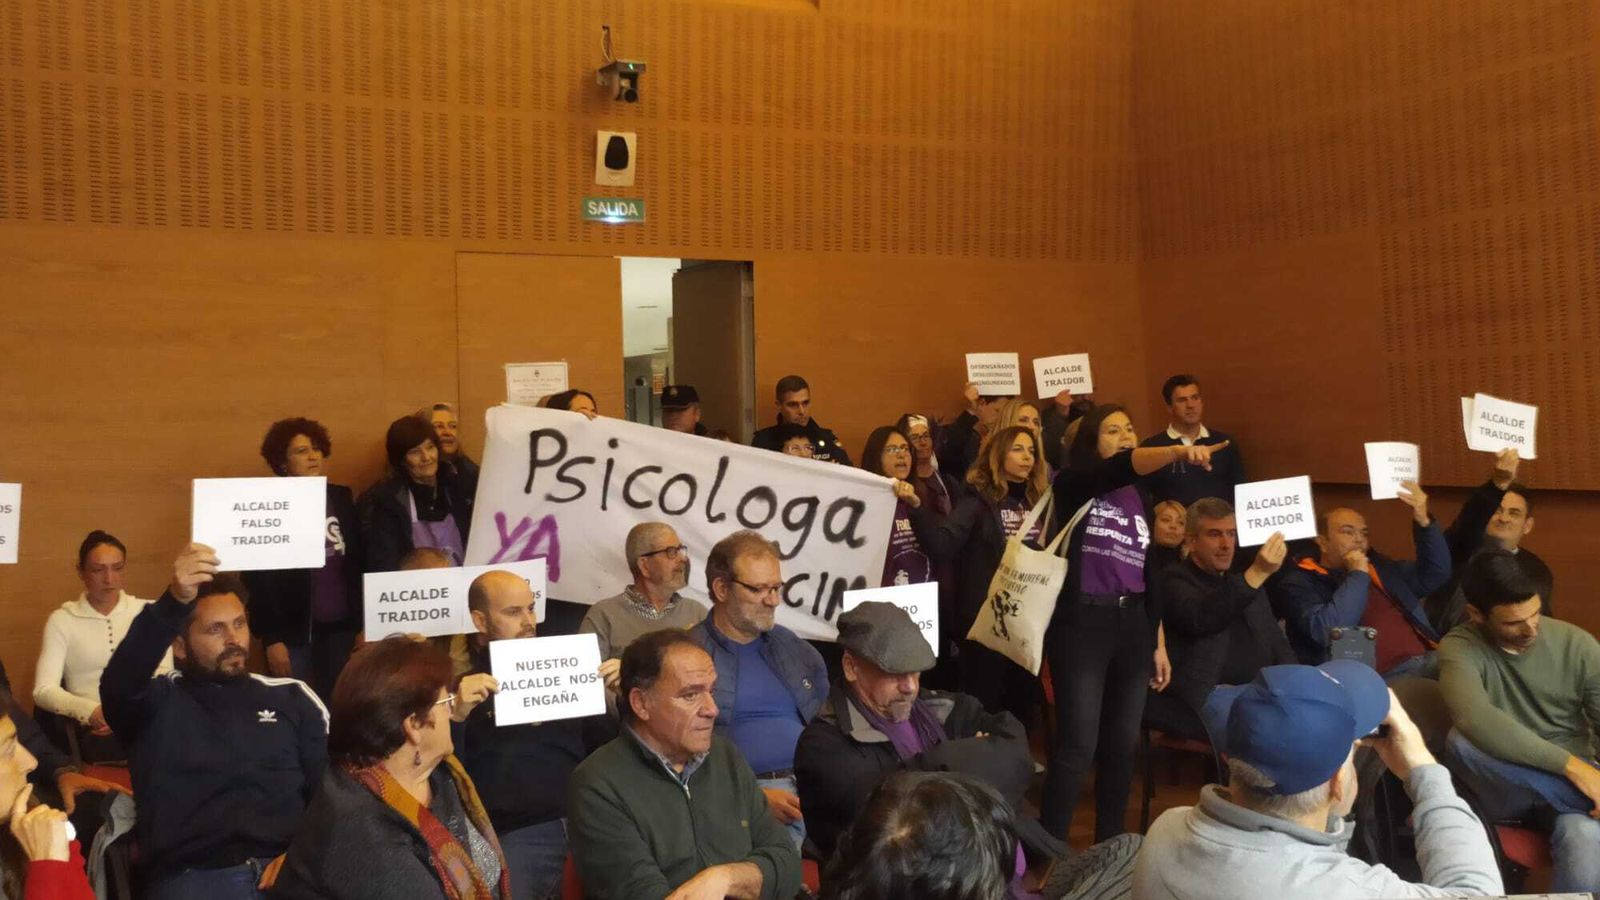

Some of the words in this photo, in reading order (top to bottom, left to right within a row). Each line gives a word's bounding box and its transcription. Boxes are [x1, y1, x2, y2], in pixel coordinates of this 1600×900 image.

[588, 200, 639, 216] SALIDA
[1043, 364, 1083, 376] ALCALDE
[1044, 376, 1085, 388] TRAIDOR
[1480, 411, 1526, 430] ALCALDE
[1479, 426, 1526, 445] TRAIDOR
[524, 428, 868, 560] Psicologa
[232, 501, 290, 513] ALCALDE
[1246, 494, 1301, 511] ALCALDE
[241, 518, 282, 528] FALSO
[1246, 512, 1304, 529] TRAIDOR
[231, 534, 290, 546] TRAIDOR
[488, 511, 561, 583] YA
[379, 587, 449, 603] ALCALDE
[378, 607, 451, 623] TRAIDOR
[515, 657, 579, 672] NUESTRO
[501, 676, 561, 692] ALCALDE
[569, 672, 598, 685] NOS
[523, 690, 579, 708] ENGAÑA
